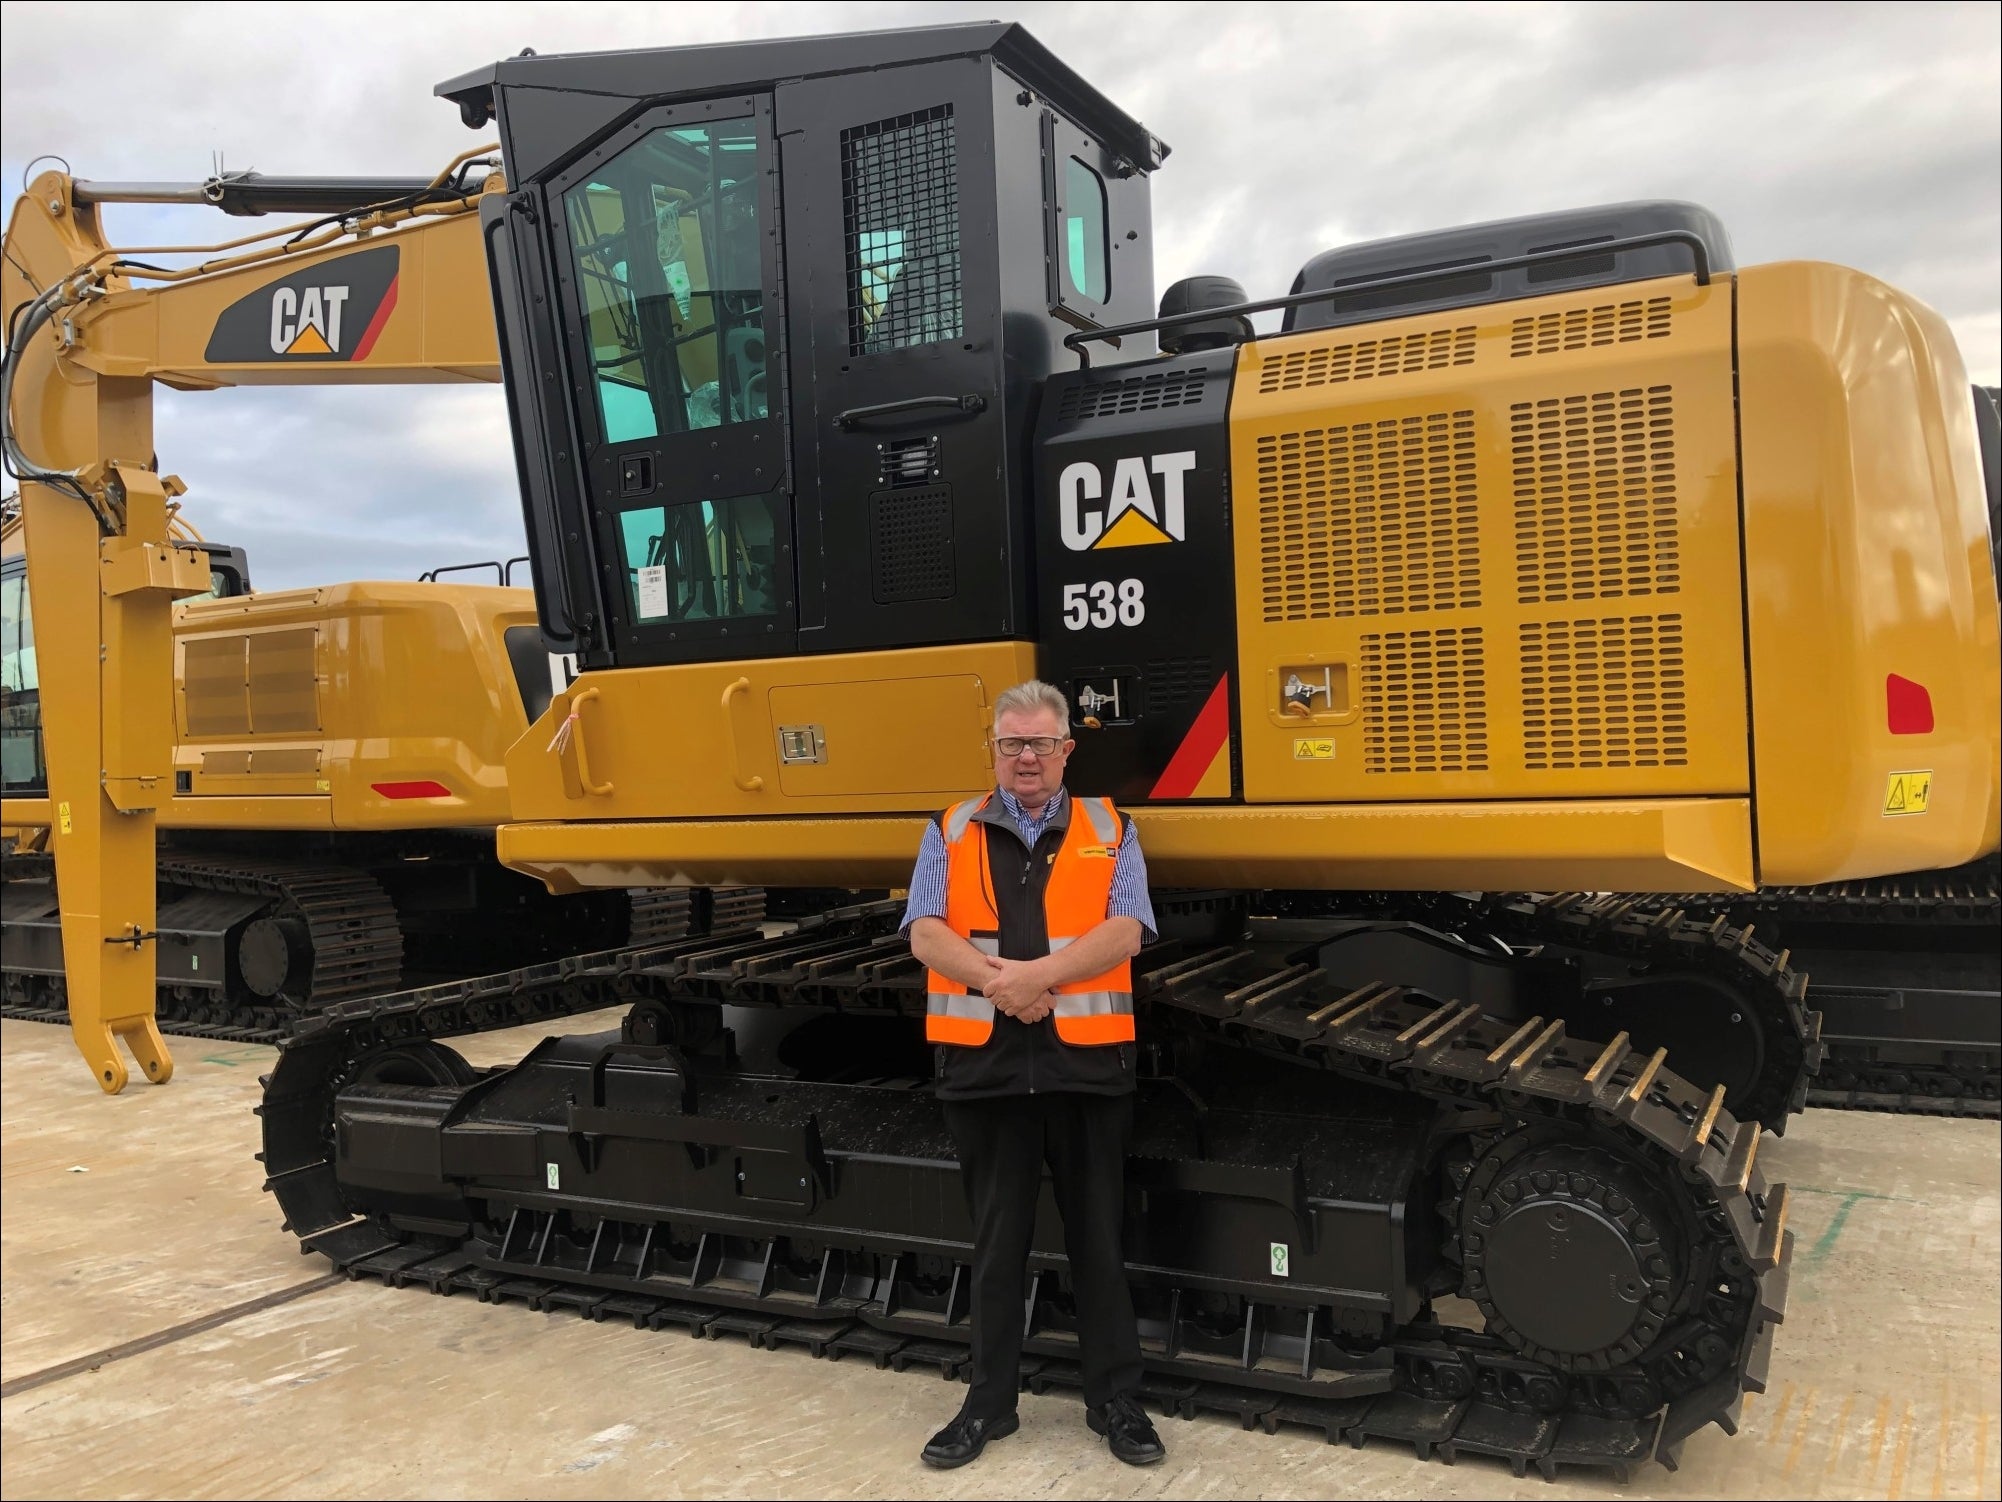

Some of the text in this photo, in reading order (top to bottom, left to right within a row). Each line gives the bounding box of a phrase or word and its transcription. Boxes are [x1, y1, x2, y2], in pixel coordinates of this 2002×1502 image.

[270, 286, 349, 354] CAT
[1059, 450, 1196, 551] CAT
[1063, 578, 1146, 631] 538
